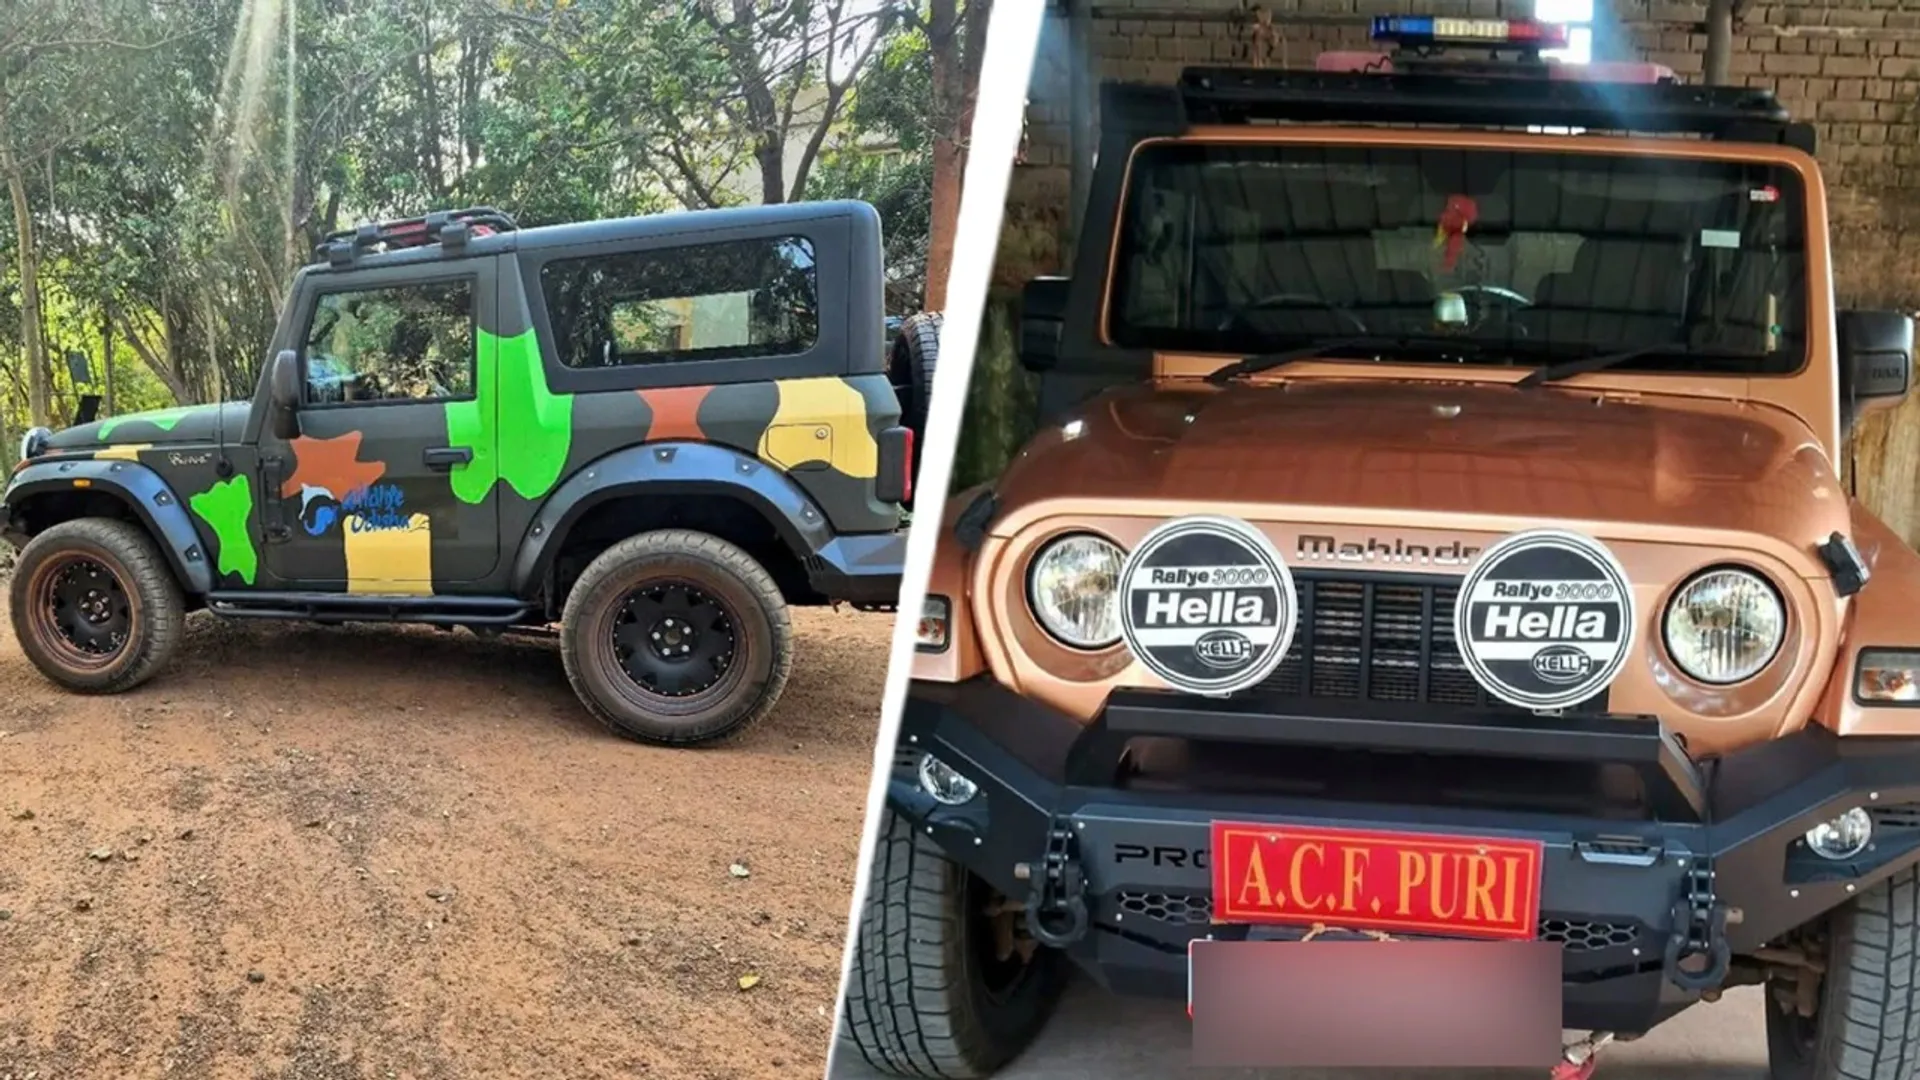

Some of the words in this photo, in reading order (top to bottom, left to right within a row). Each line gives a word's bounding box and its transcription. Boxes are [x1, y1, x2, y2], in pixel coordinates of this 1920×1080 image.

[1296, 534, 1482, 564] Mahindr
[1151, 568, 1209, 587] Rallye
[1211, 567, 1269, 585] 3000
[1492, 581, 1554, 601] Rallye
[1555, 582, 1614, 600] 3000
[1144, 590, 1265, 625] Hella
[1483, 604, 1607, 640] Hella
[1198, 640, 1253, 656] HELLA
[1534, 653, 1592, 671] HELLA
[1237, 839, 1382, 914] A.C.F.
[1394, 849, 1521, 924] PURI
